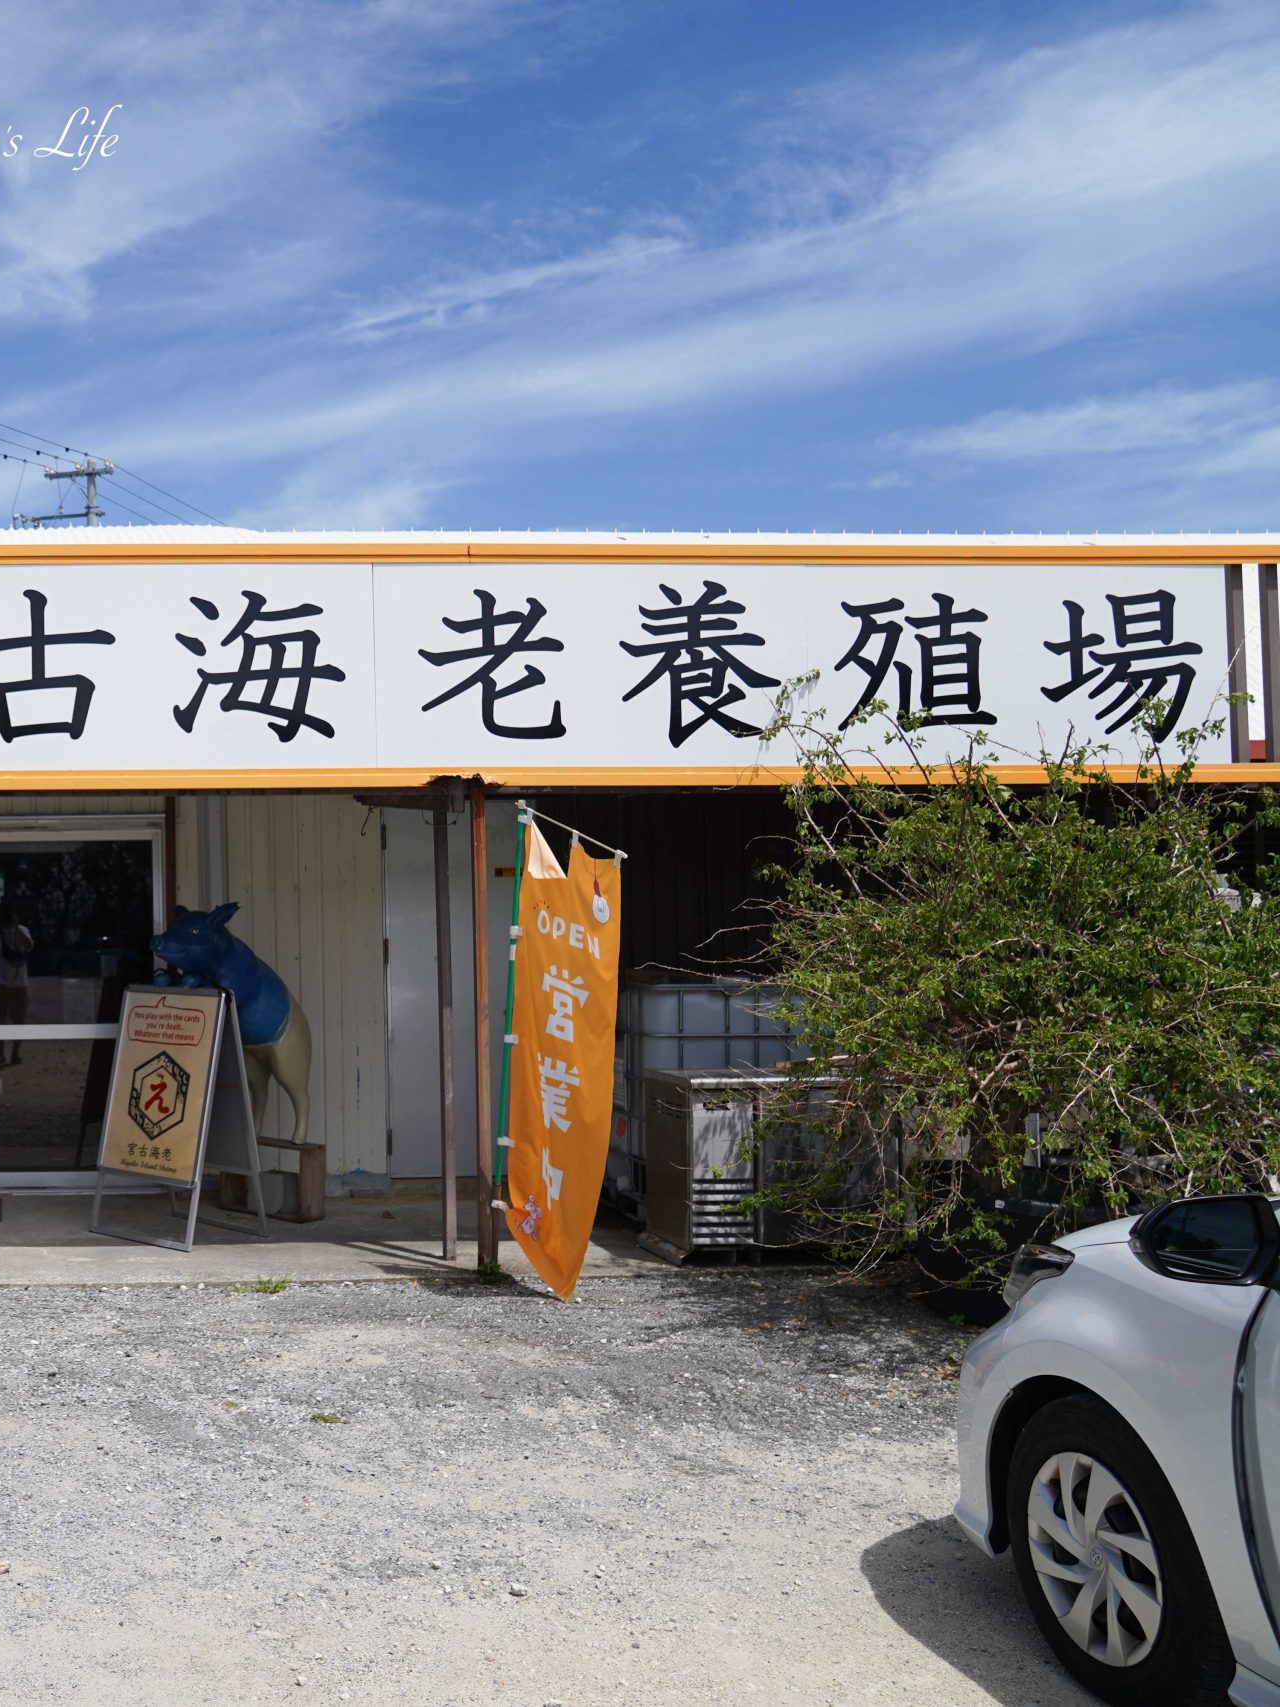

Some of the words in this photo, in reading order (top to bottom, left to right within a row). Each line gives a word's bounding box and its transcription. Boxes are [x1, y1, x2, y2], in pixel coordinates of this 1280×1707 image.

[537, 909, 600, 960] OPEN
[145, 1012, 158, 1021] play
[183, 1015, 200, 1023] cards
[146, 1021, 164, 1030] you're
[134, 1030, 161, 1039] Whatever
[161, 1032, 175, 1040] that
[537, 964, 589, 1211] 営業中
[127, 1142, 172, 1162] 宮古海老
